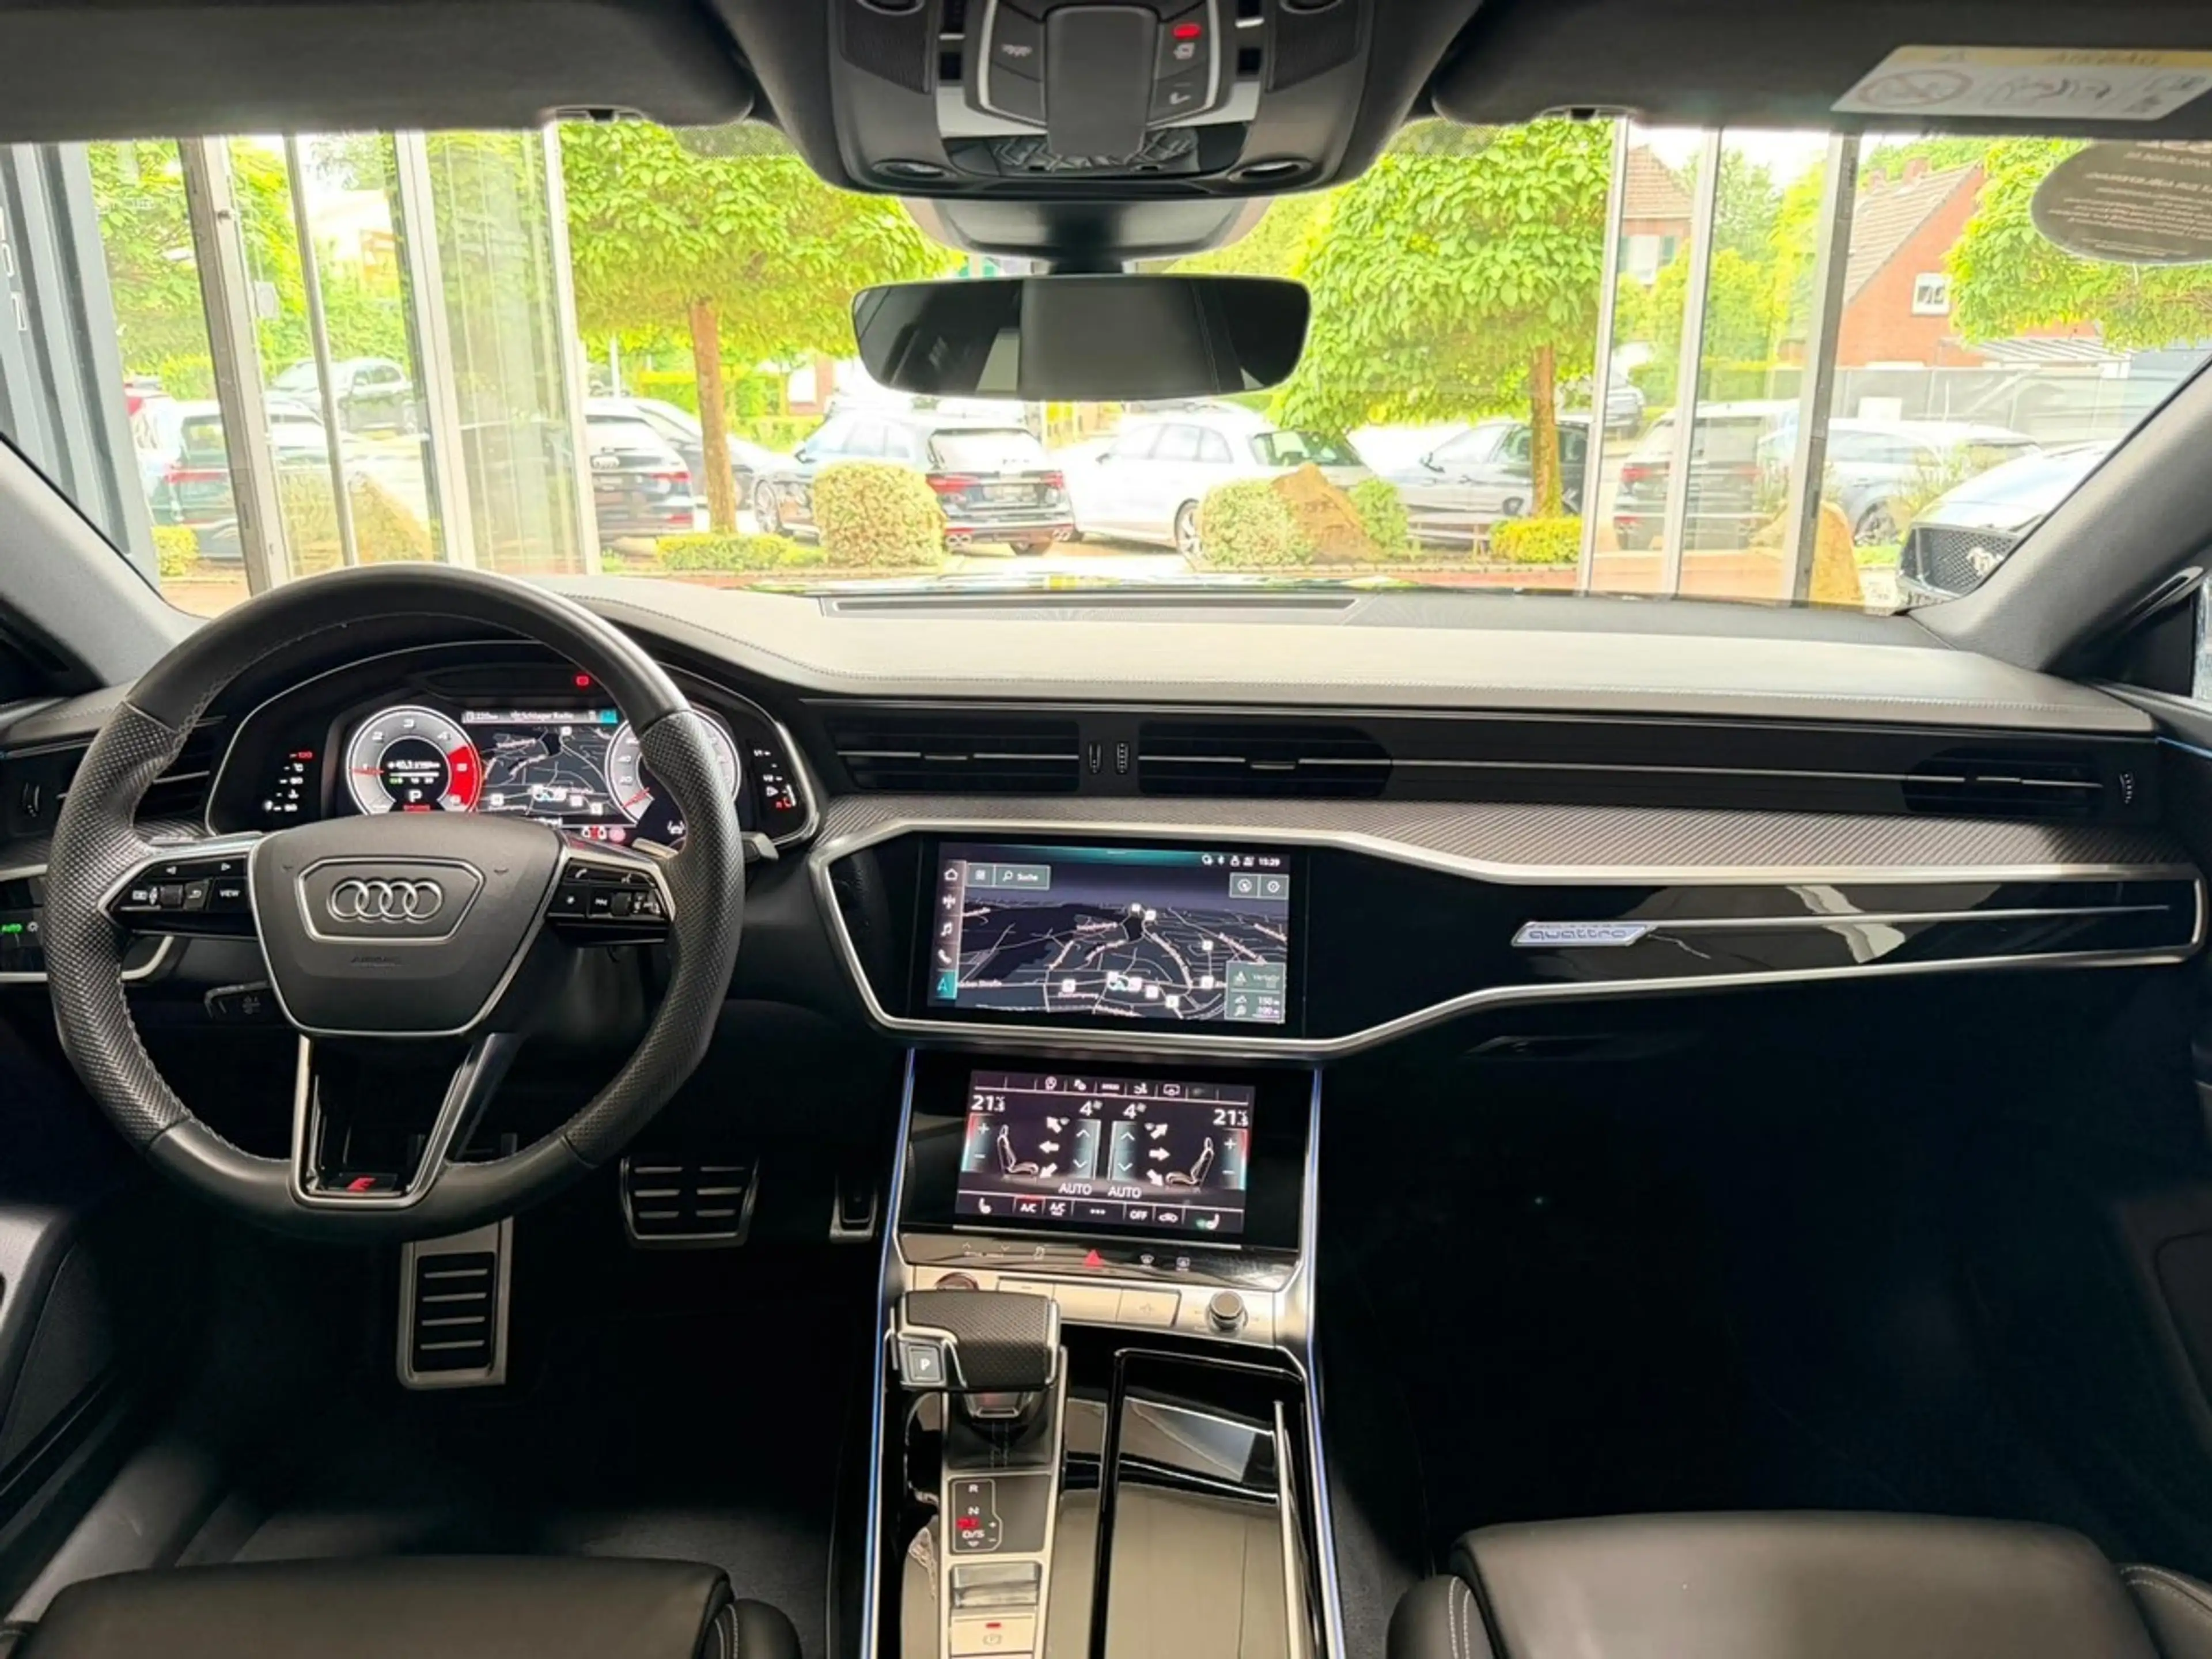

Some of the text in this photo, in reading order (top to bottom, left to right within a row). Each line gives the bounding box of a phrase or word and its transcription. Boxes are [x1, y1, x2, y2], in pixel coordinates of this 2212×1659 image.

[403, 719, 415, 728] 3
[372, 731, 383, 740] 2
[408, 789, 422, 803] P
[219, 889, 241, 898] VIEW
[1528, 929, 1628, 941] quattro
[1079, 1100, 1093, 1116] 4
[1123, 1103, 1137, 1119] 4
[1058, 1183, 1093, 1195] AUTO
[1107, 1185, 1143, 1199] AUTO
[1020, 1203, 1037, 1213] A/C
[1130, 1210, 1149, 1220] OFF
[920, 1358, 931, 1370] P
[969, 1484, 978, 1493] R
[968, 1506, 979, 1516] N
[962, 1531, 984, 1539] D/S
